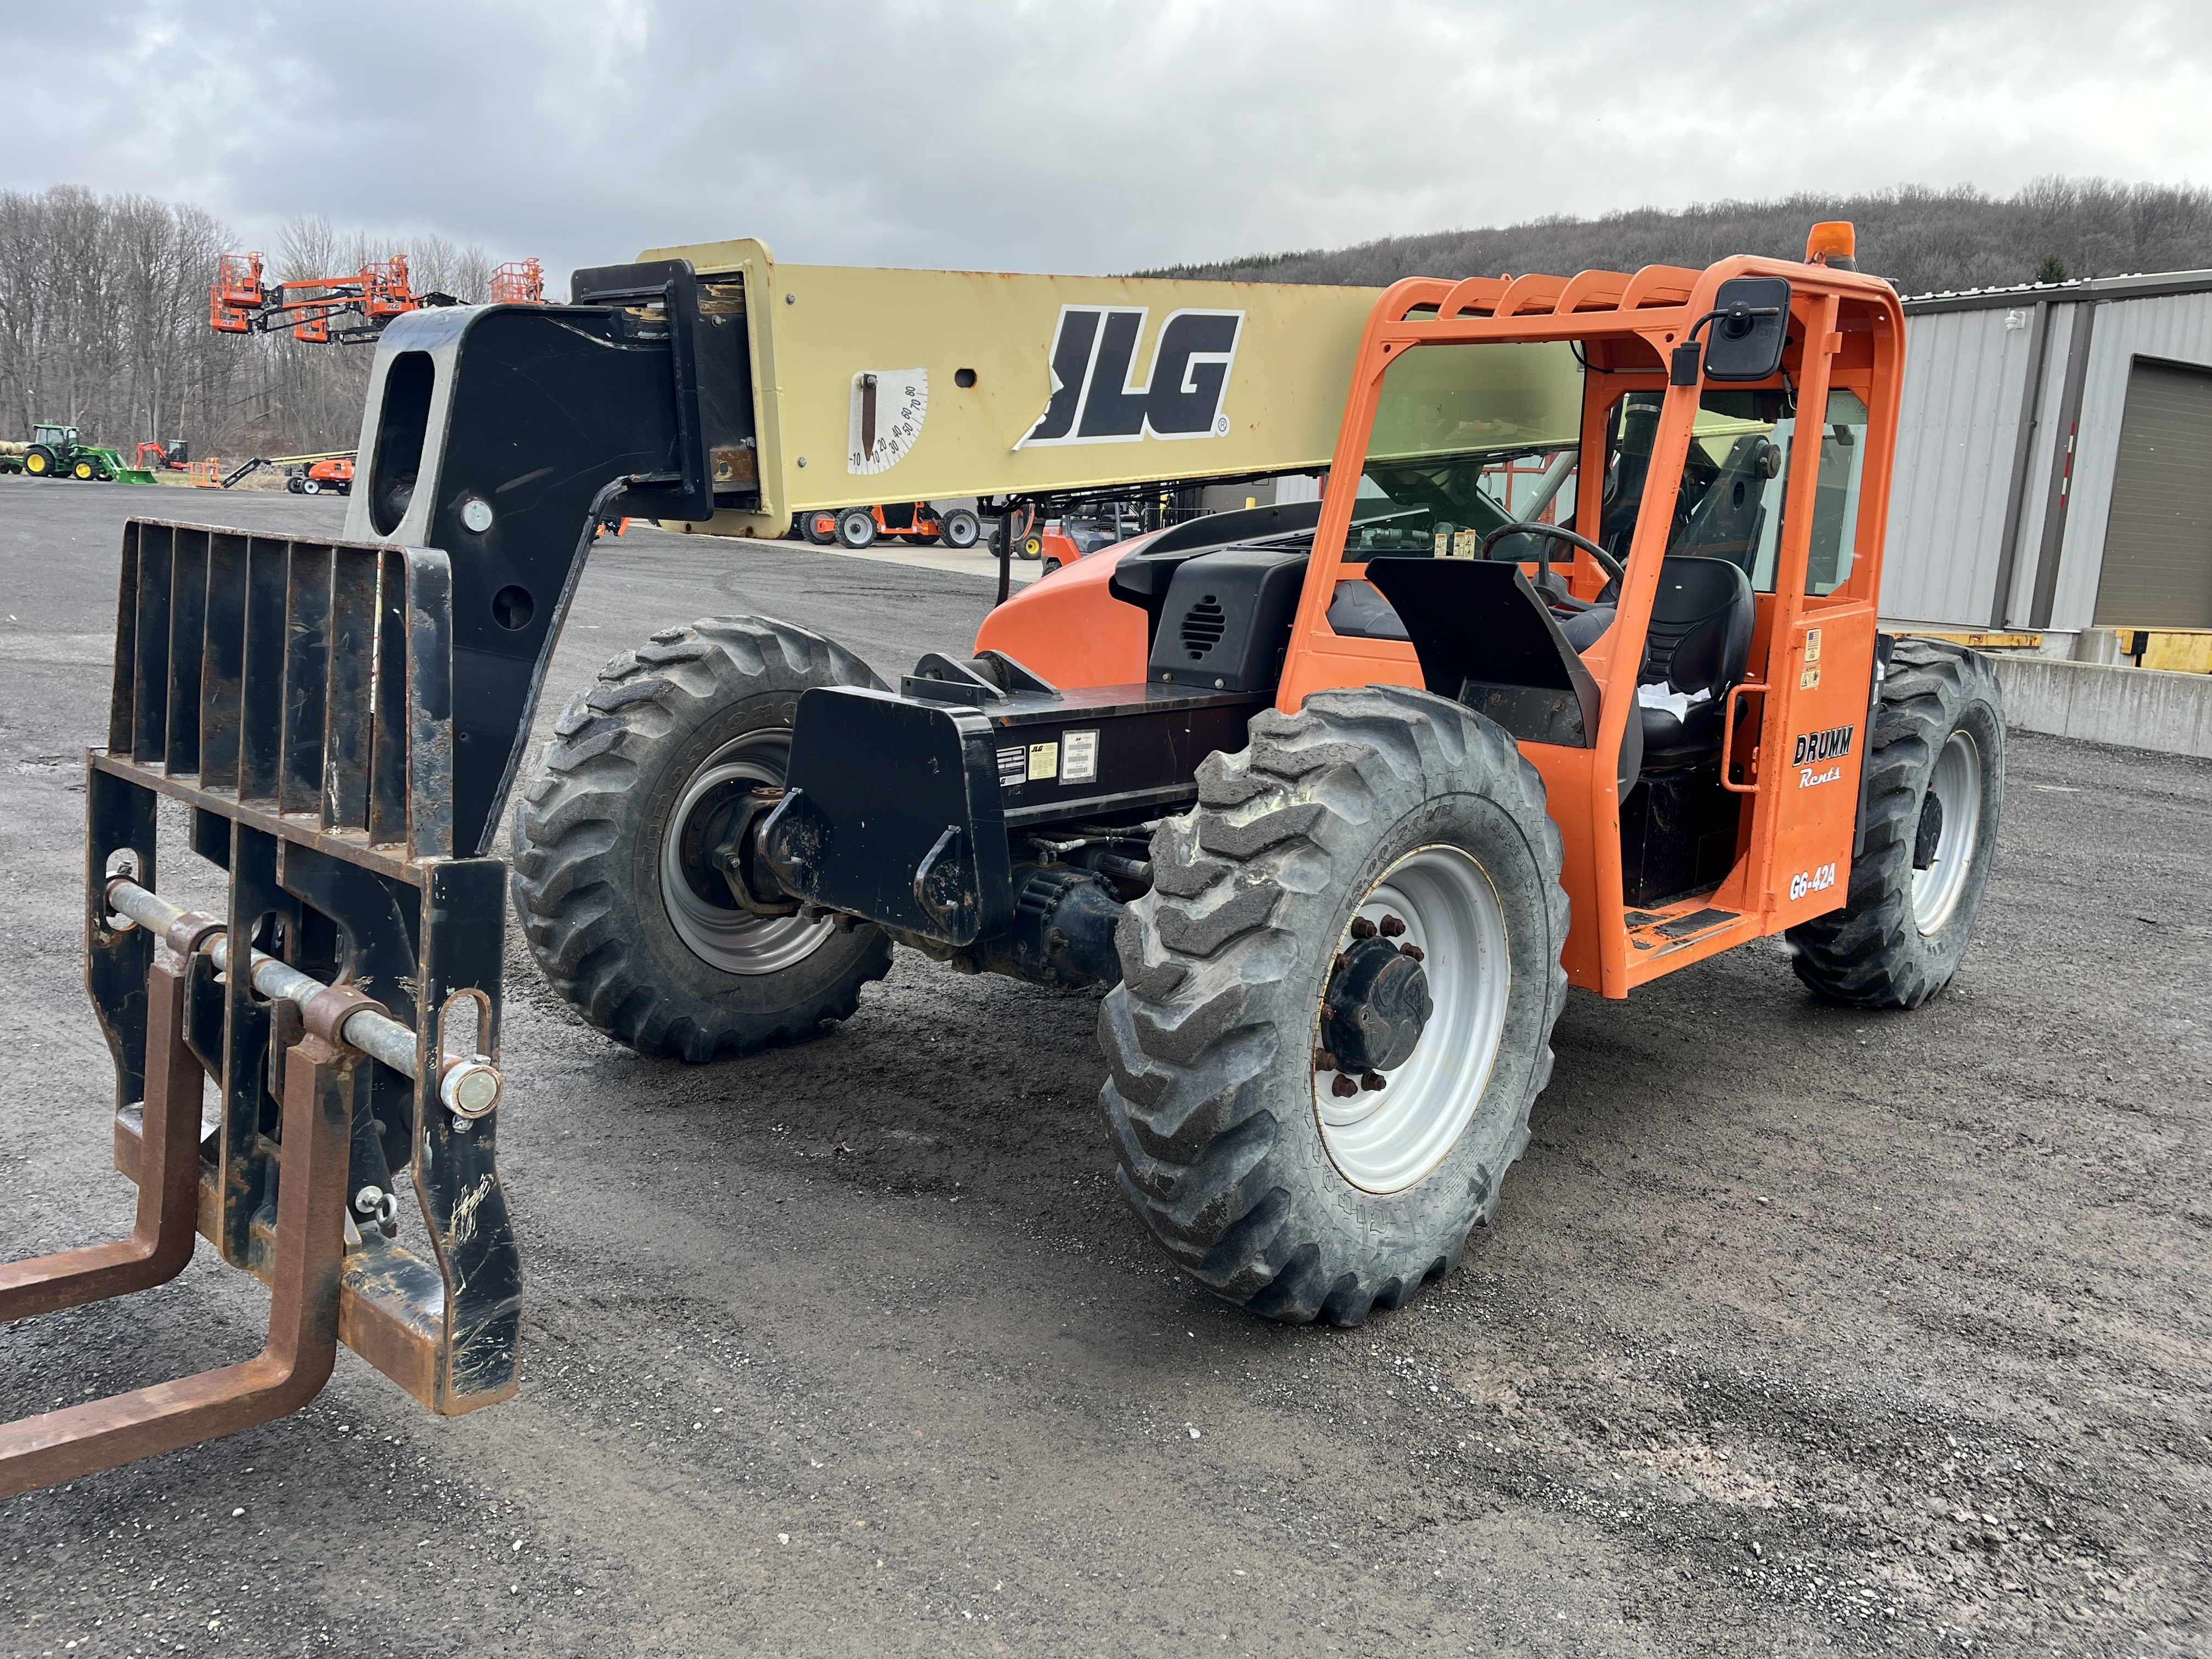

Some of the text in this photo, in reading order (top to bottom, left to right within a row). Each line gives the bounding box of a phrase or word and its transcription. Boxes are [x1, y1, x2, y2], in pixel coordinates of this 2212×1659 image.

[1026, 309, 1241, 439] JLG
[905, 386, 915, 397] 80
[910, 399, 921, 411] 70
[901, 407, 912, 420] 60
[891, 425, 902, 438] 40
[902, 422, 913, 436] 50
[878, 437, 887, 452] 20
[889, 439, 899, 454] 30
[849, 452, 861, 466] -10
[871, 450, 880, 464] 10
[1792, 724, 1854, 768] DRUMM
[1798, 766, 1842, 789] Rents
[1790, 861, 1835, 901] G6-42A
[1490, 818, 1544, 1043] SUPER GROUND GRIP
[1490, 1081, 1508, 1117] NYLON
